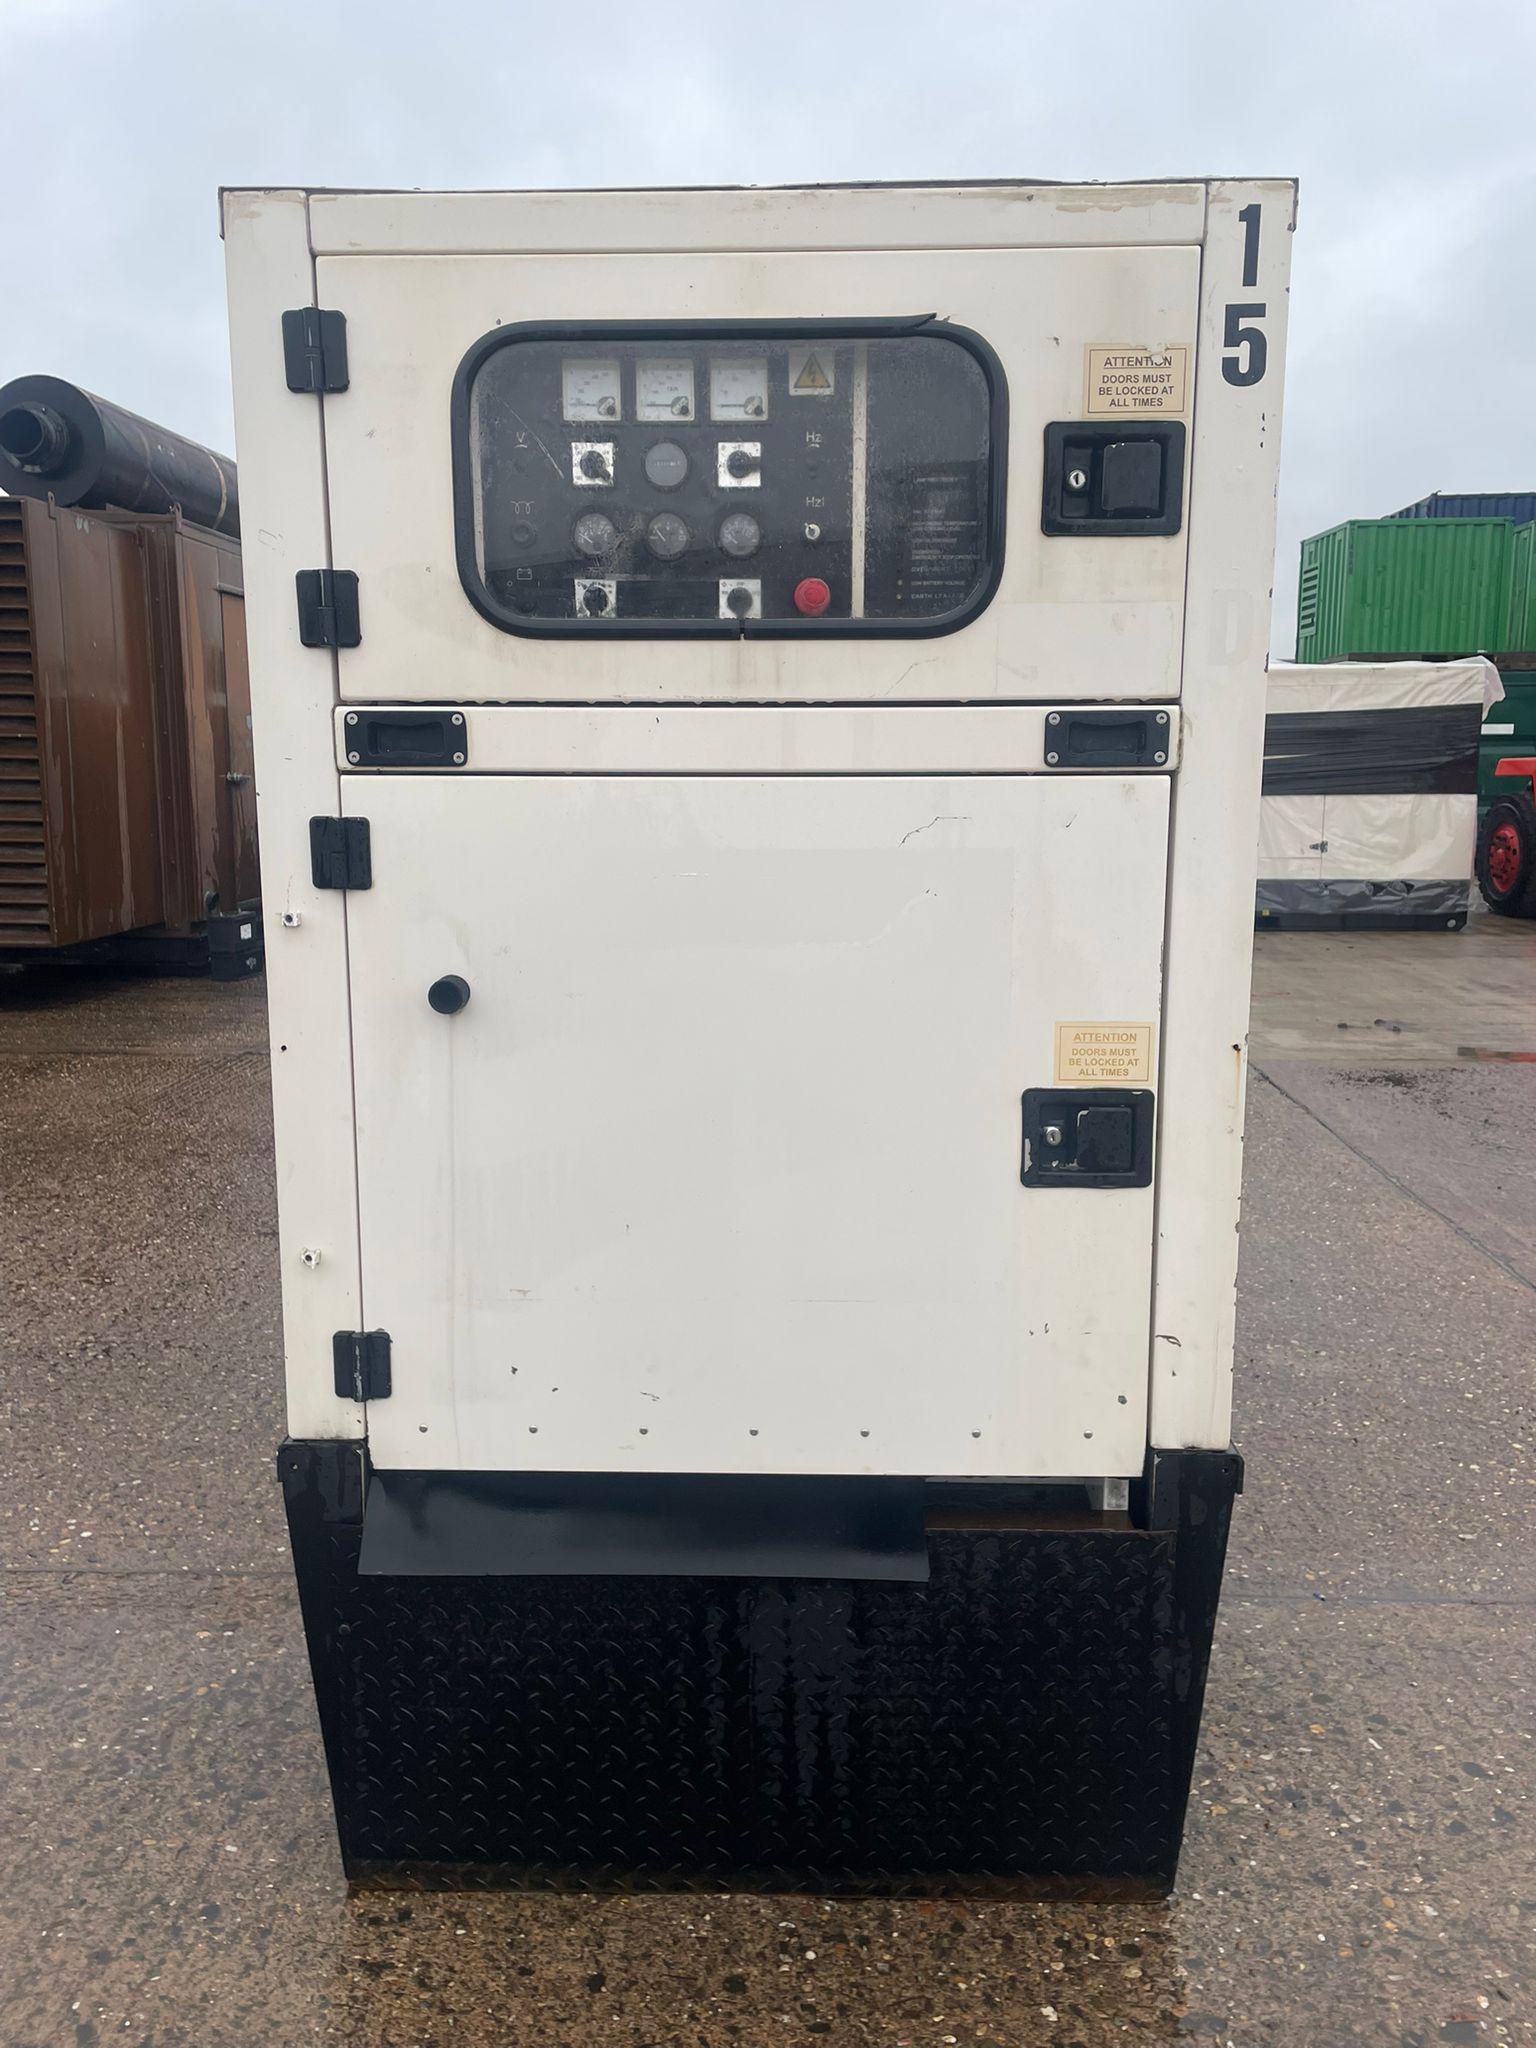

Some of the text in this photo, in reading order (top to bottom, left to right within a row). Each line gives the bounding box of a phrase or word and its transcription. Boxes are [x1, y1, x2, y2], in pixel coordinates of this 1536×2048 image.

[1102, 374, 1172, 384] DOORS MUST
[1098, 386, 1175, 396] BE LOCKED AT
[1109, 397, 1163, 407] ALL TIMES
[1073, 1032, 1137, 1042] ATTENTION
[1071, 1048, 1137, 1057] DOORS MUST
[1068, 1058, 1140, 1067] BE LOCKED AT
[1078, 1068, 1129, 1076] ALL TIMES
